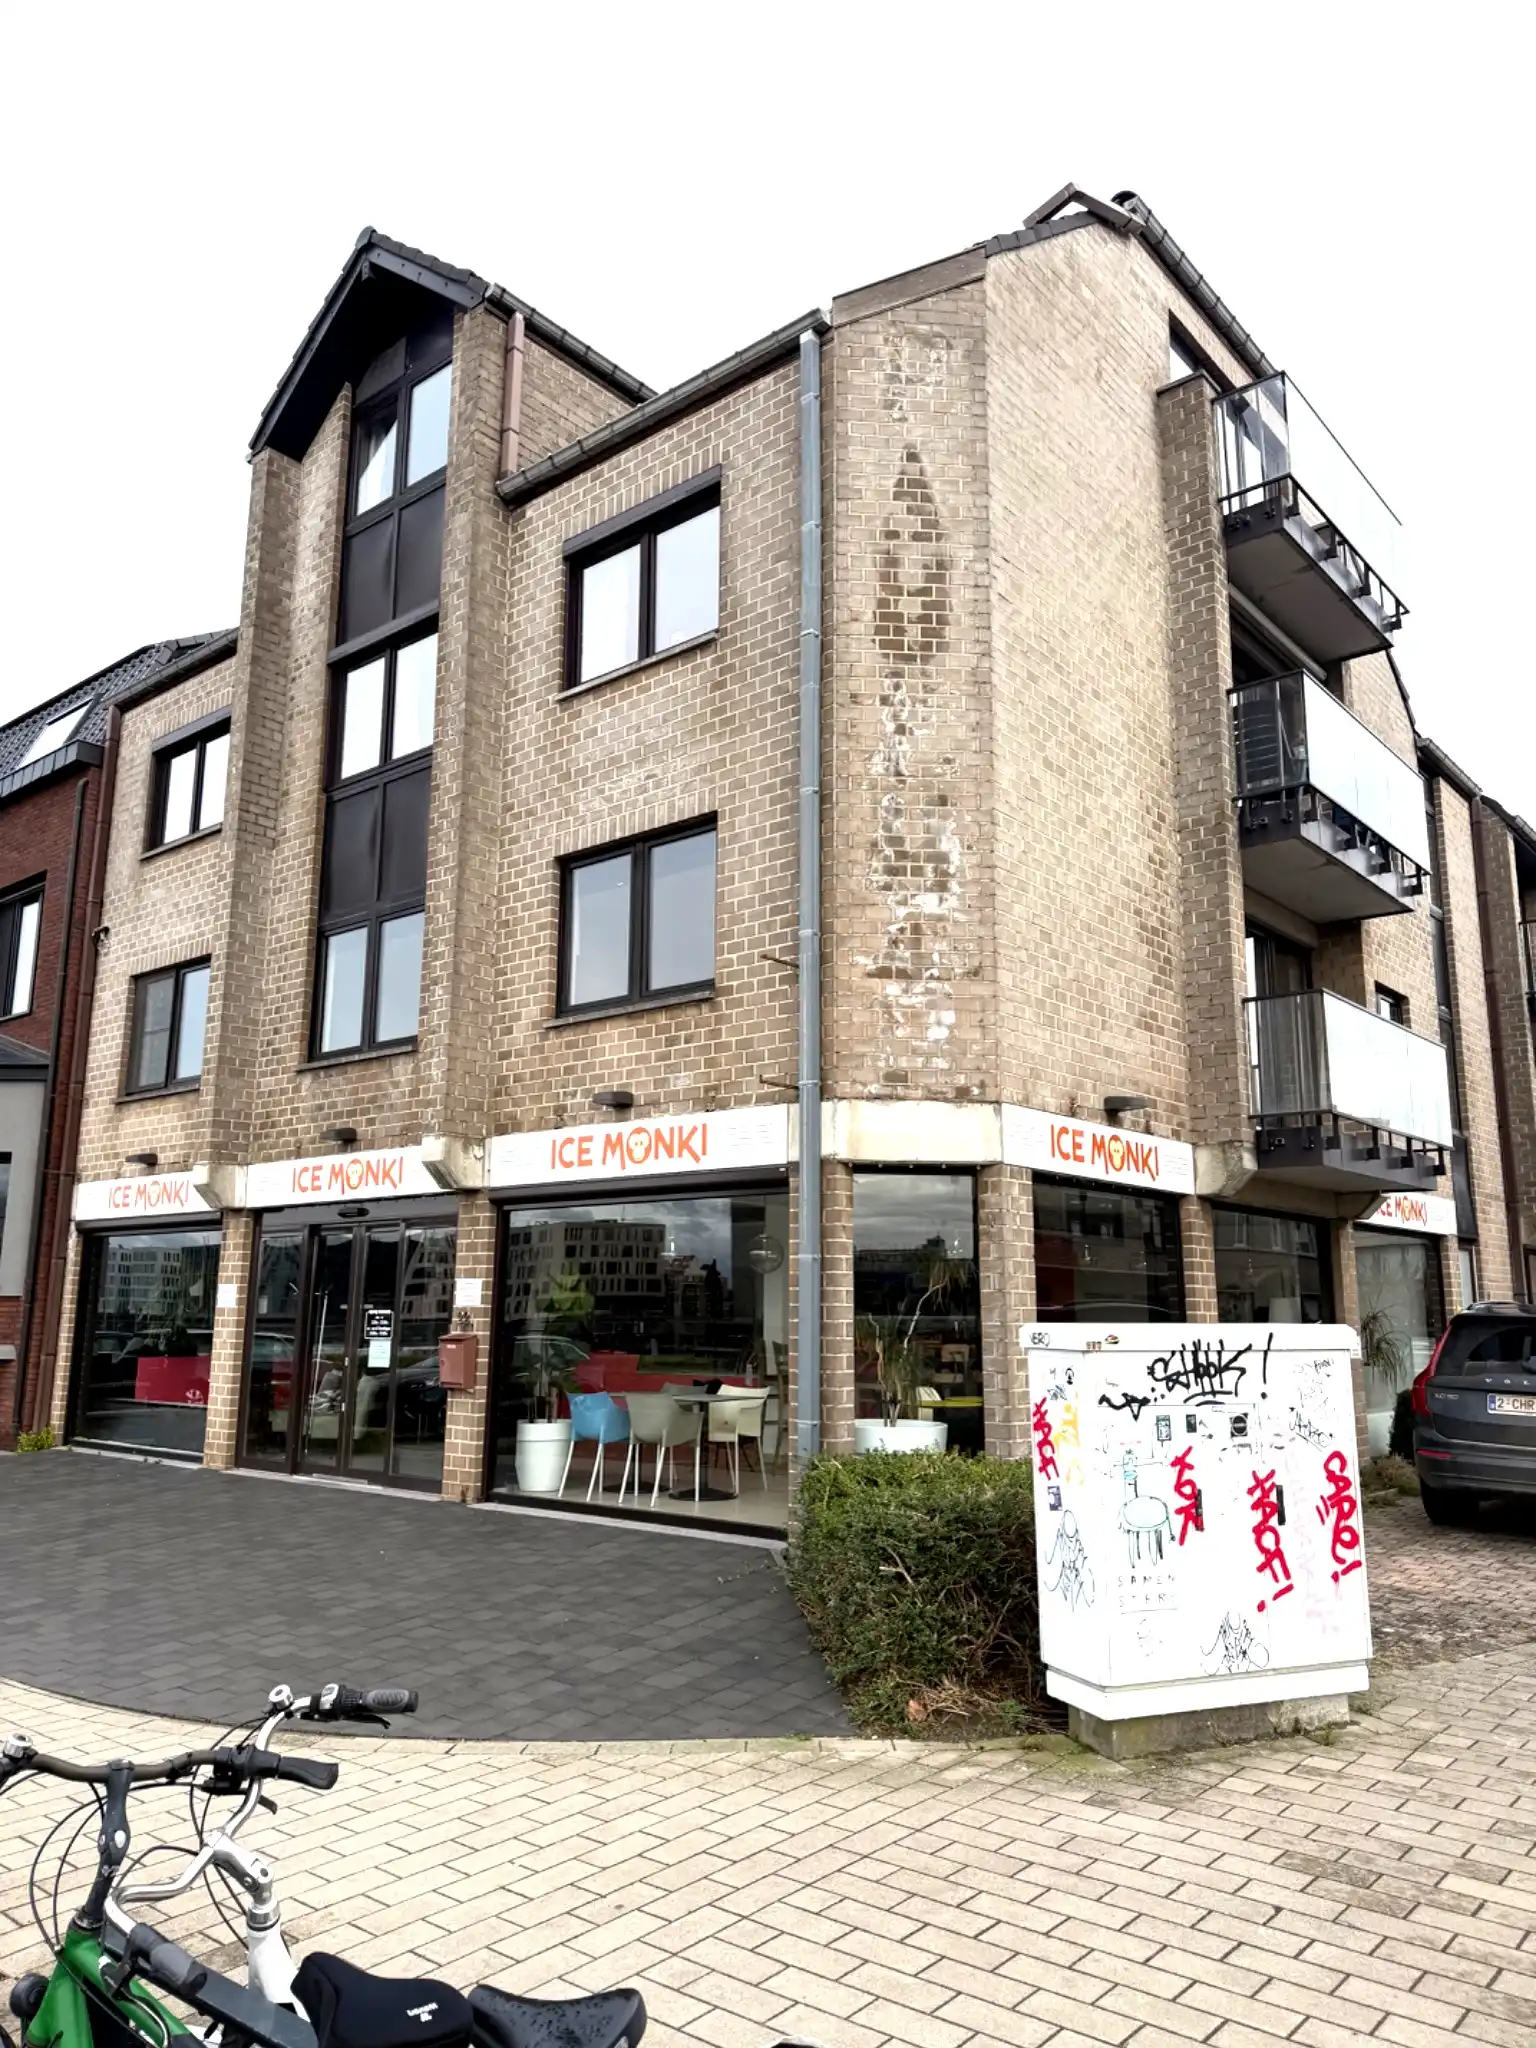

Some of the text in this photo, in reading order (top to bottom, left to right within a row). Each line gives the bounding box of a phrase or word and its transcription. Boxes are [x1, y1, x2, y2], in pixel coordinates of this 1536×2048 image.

[551, 1122, 708, 1170] ICE MONKI
[1050, 1123, 1160, 1182] ICE MONKI
[108, 1178, 189, 1211] ICE MONKI
[291, 1156, 404, 1195] ICE MONKI
[1376, 1195, 1428, 1227] CE MONKI
